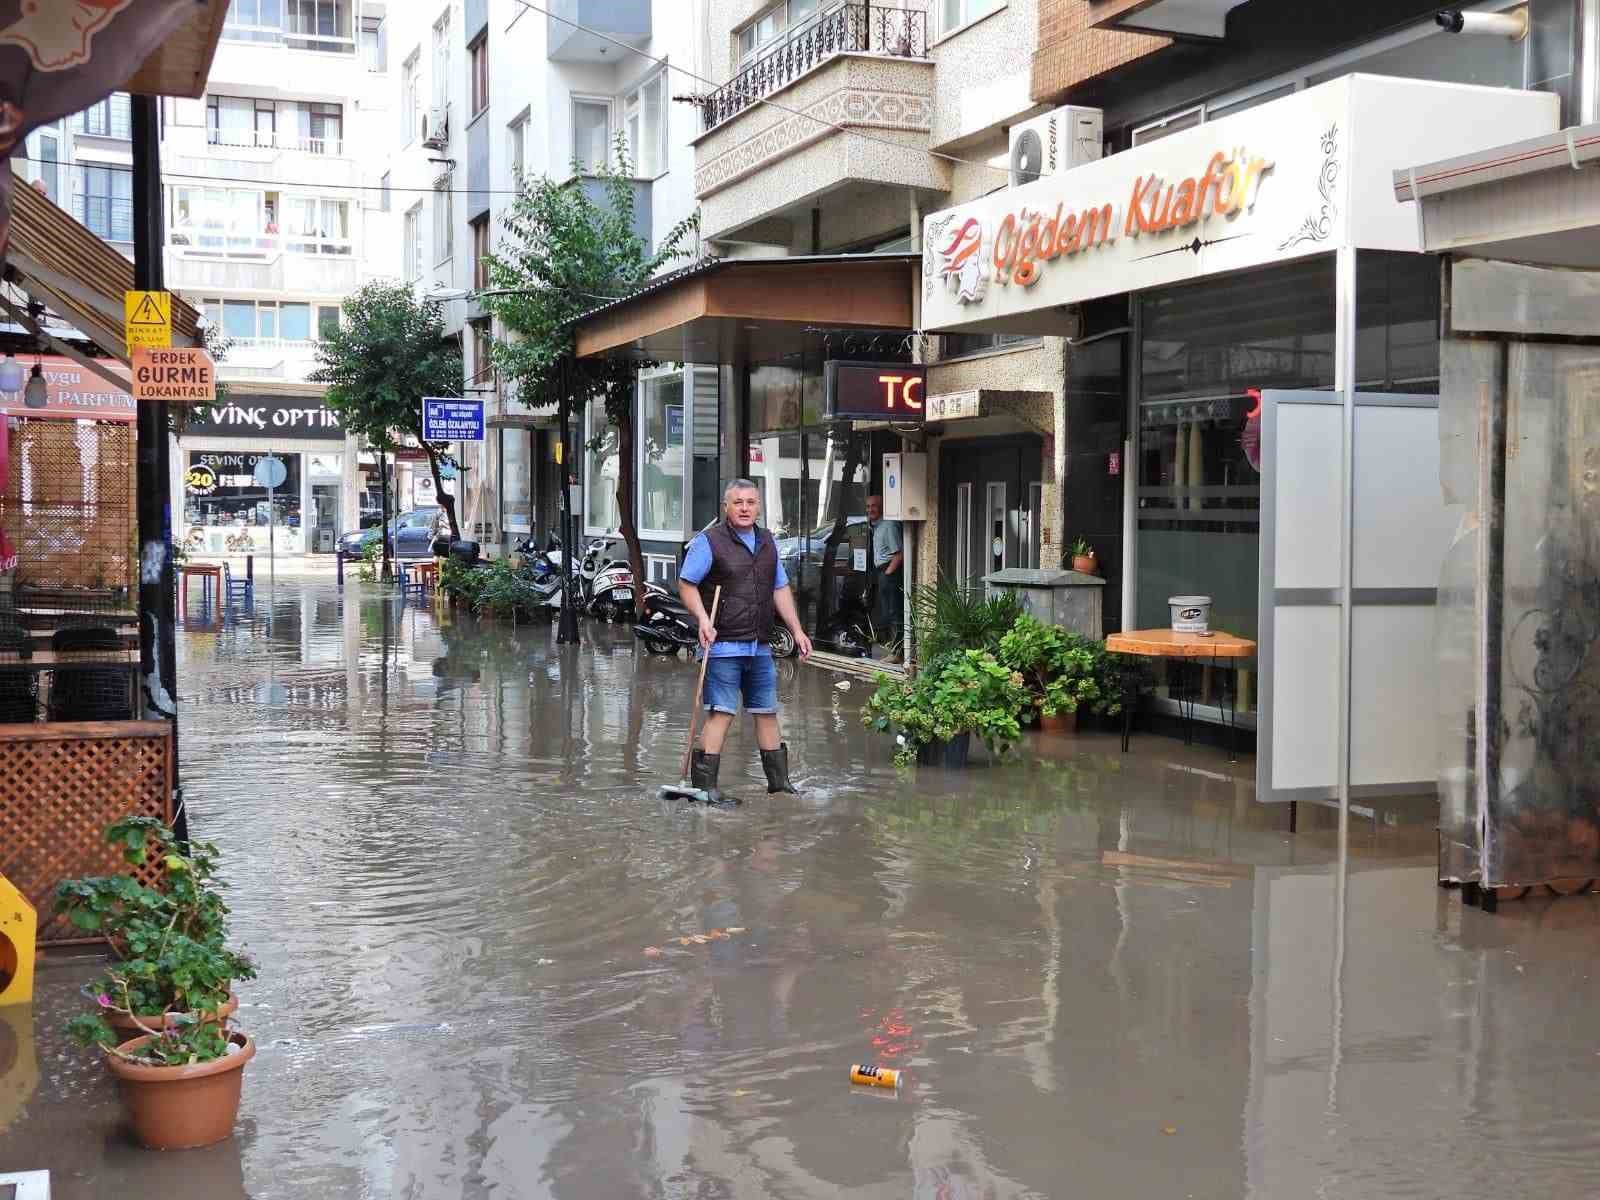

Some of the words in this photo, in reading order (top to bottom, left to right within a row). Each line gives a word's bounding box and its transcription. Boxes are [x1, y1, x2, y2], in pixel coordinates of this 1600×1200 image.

[1048, 116, 1057, 170] arçelik
[994, 202, 1113, 286] Çiğdem
[1125, 146, 1268, 239] Kuaför
[151, 352, 197, 364] ERDEK
[137, 366, 209, 384] GURME
[140, 386, 209, 397] LOKANTASI
[272, 404, 340, 428] OPTİK
[931, 399, 946, 416] NO
